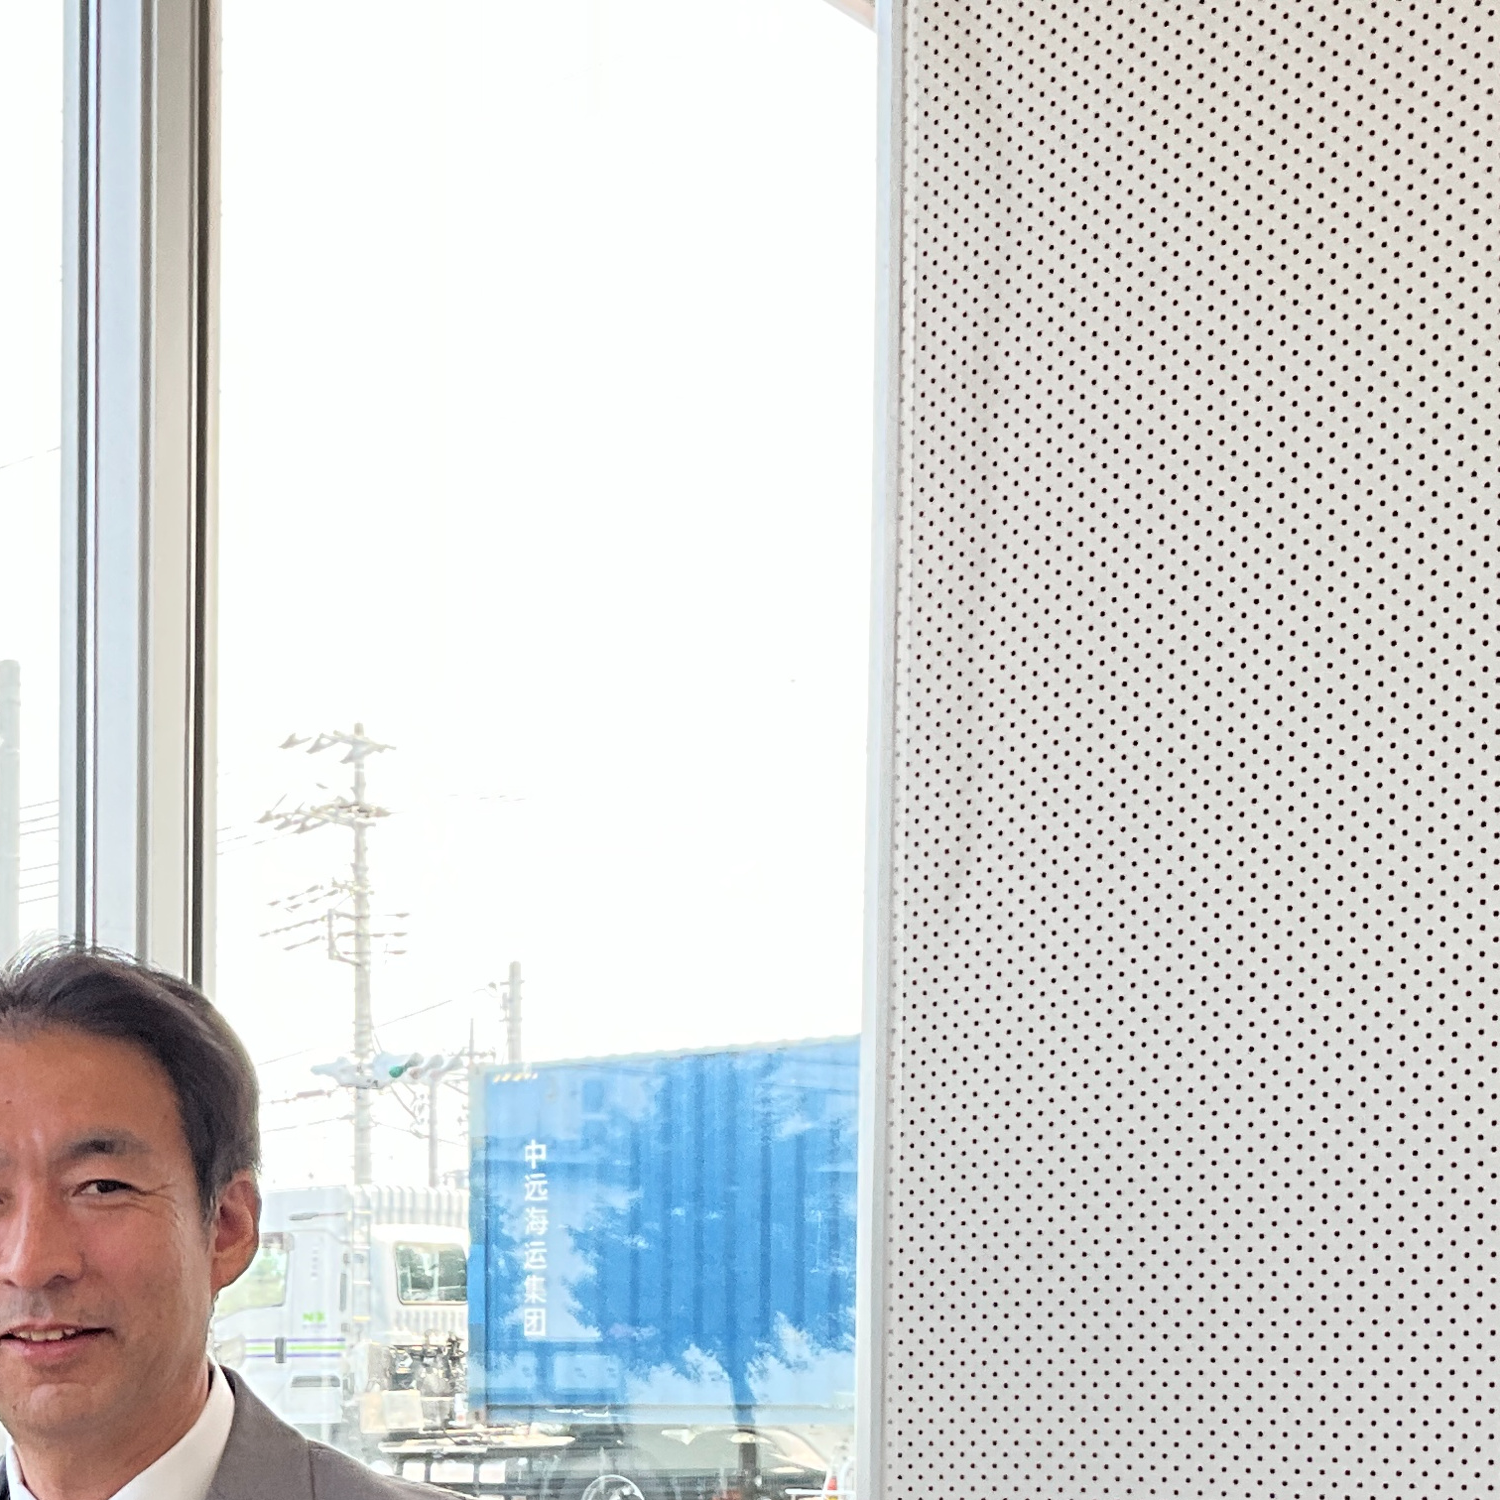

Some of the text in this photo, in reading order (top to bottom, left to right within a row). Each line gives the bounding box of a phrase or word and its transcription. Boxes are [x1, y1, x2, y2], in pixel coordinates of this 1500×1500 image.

[523, 1139, 548, 1338] 中远海运集团
